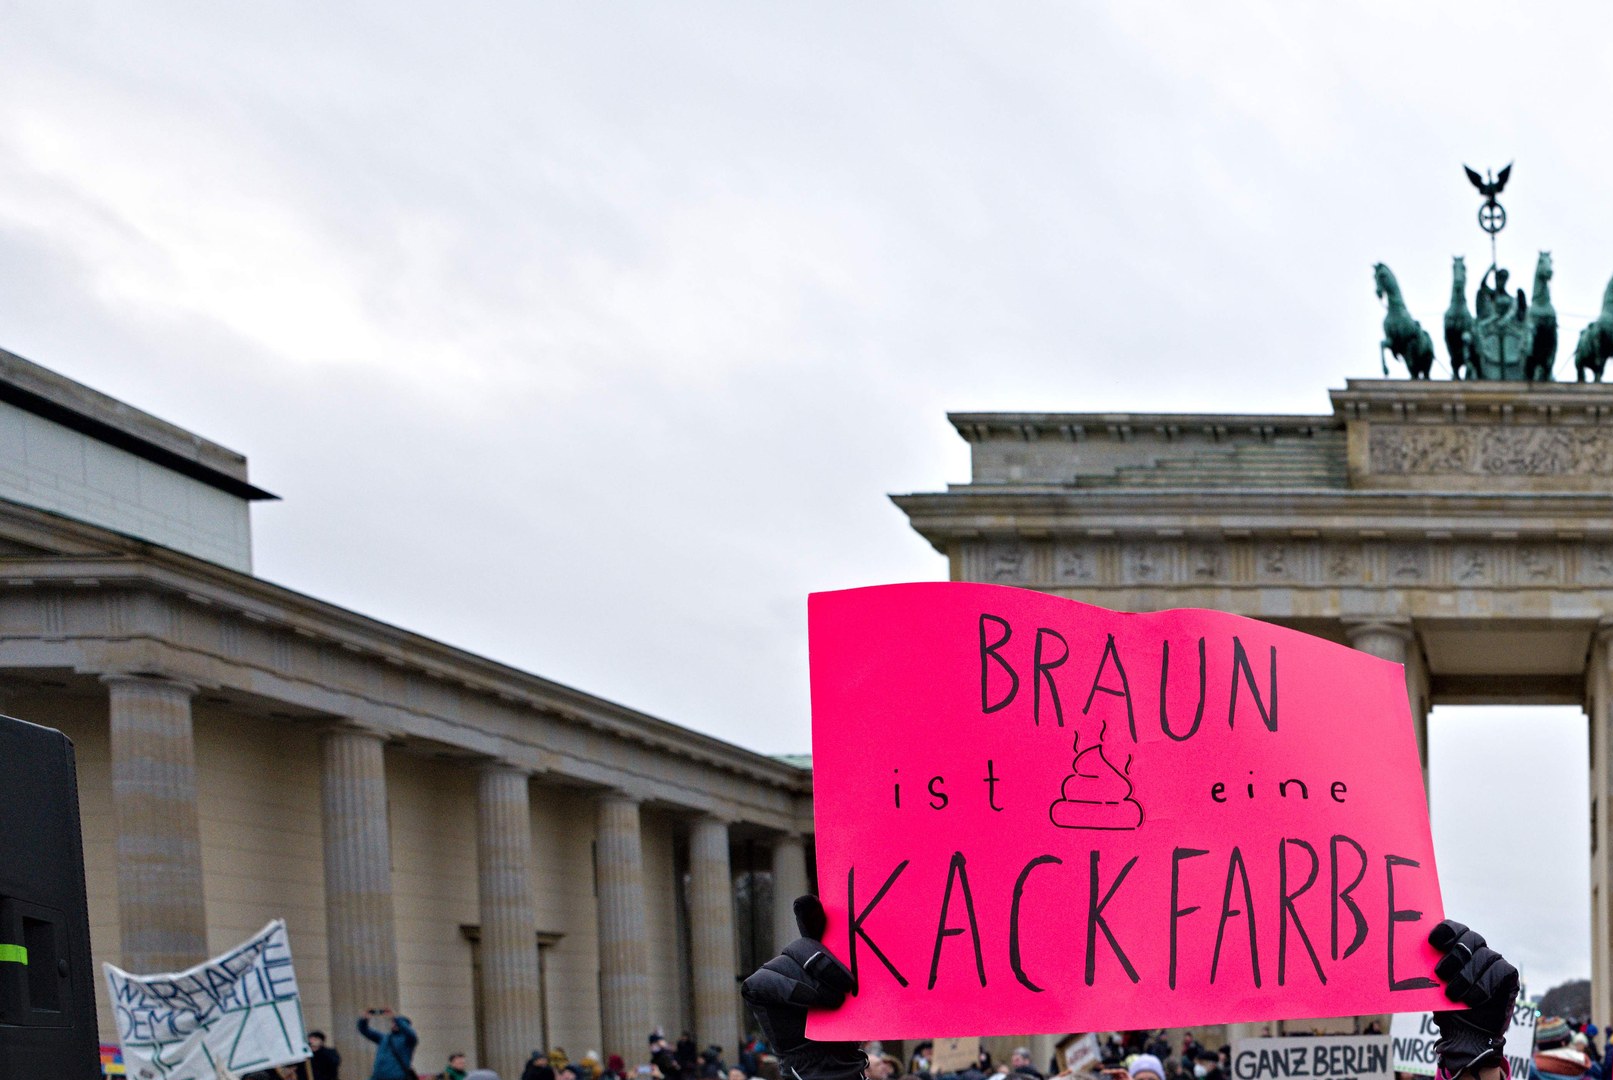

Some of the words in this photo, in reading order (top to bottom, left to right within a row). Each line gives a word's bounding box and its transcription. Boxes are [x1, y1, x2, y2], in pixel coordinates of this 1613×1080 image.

[979, 612, 1278, 743] BRAUN
[893, 759, 1005, 812] ist
[1211, 769, 1349, 805] eine
[848, 834, 1440, 998] KACKFARBE
[1235, 1047, 1310, 1080] GANZ
